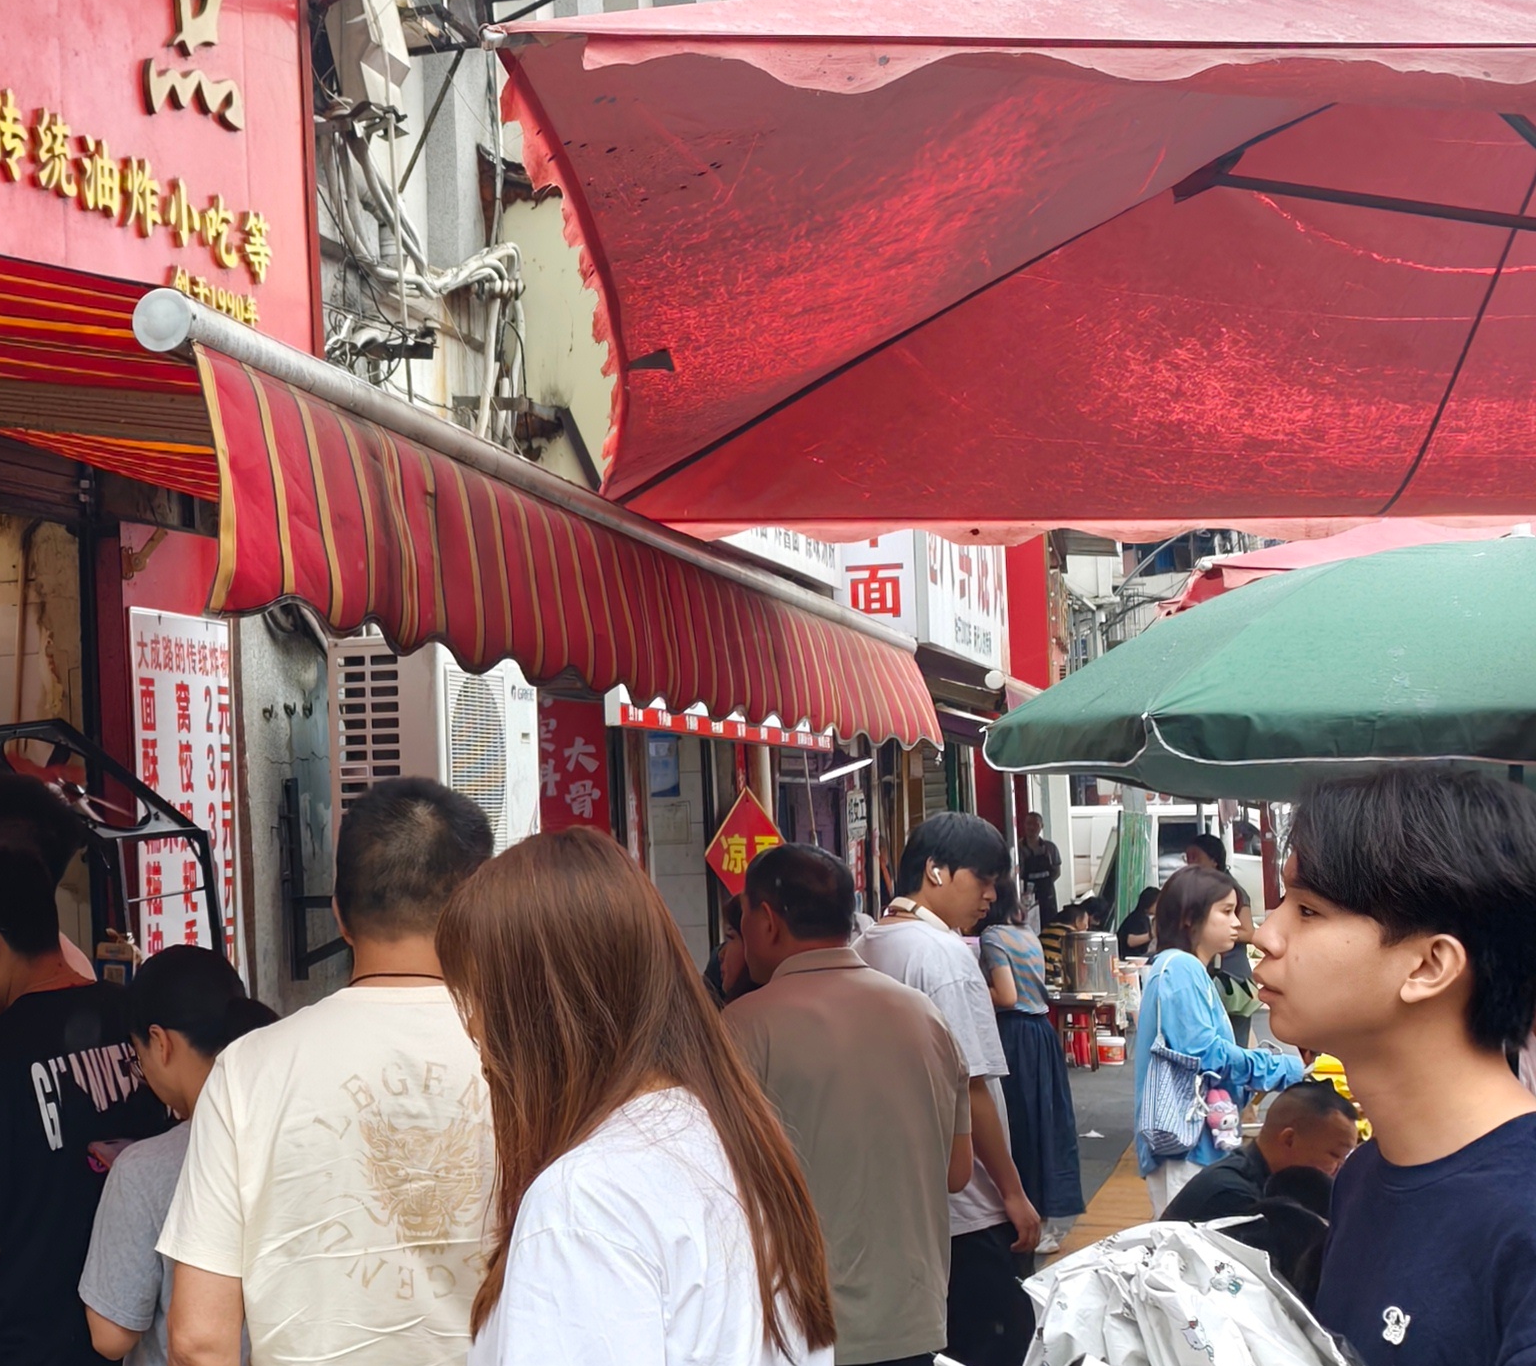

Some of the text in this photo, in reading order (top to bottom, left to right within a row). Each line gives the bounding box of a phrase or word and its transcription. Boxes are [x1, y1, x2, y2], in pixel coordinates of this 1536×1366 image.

[845, 538, 904, 618] 面
[137, 632, 229, 678] 大成路的传统炸物
[139, 677, 230, 735] 面窝 2元
